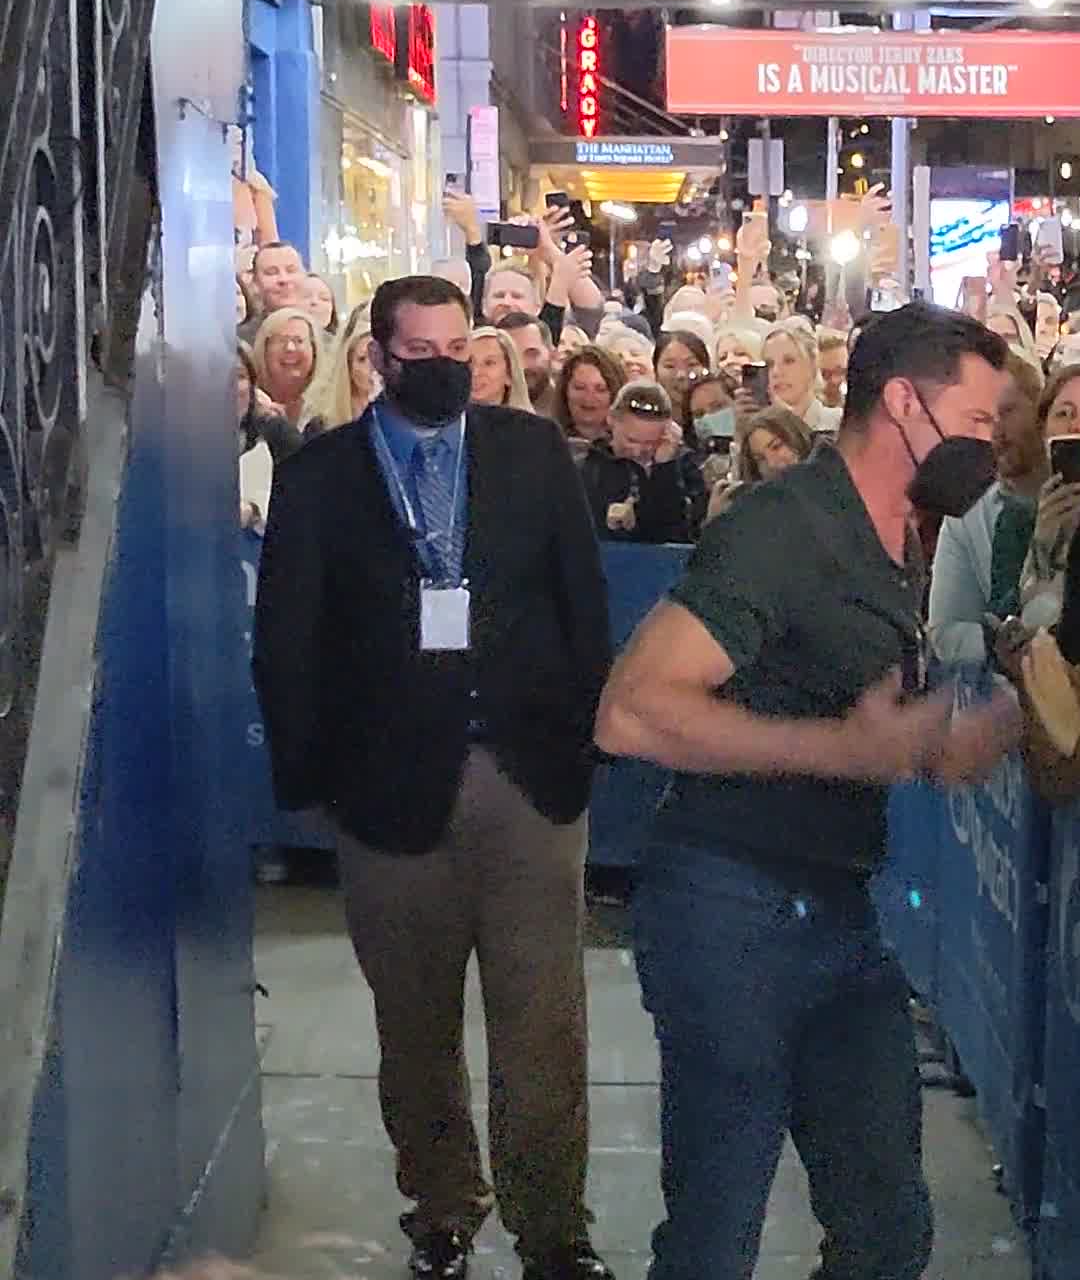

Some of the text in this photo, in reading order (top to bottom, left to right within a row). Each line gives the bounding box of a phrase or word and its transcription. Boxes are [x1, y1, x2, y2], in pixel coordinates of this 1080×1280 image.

[758, 64, 780, 94] IS
[787, 64, 803, 94] A
[811, 64, 911, 96] MUSICAL
[601, 143, 672, 154] MANHATTAN
